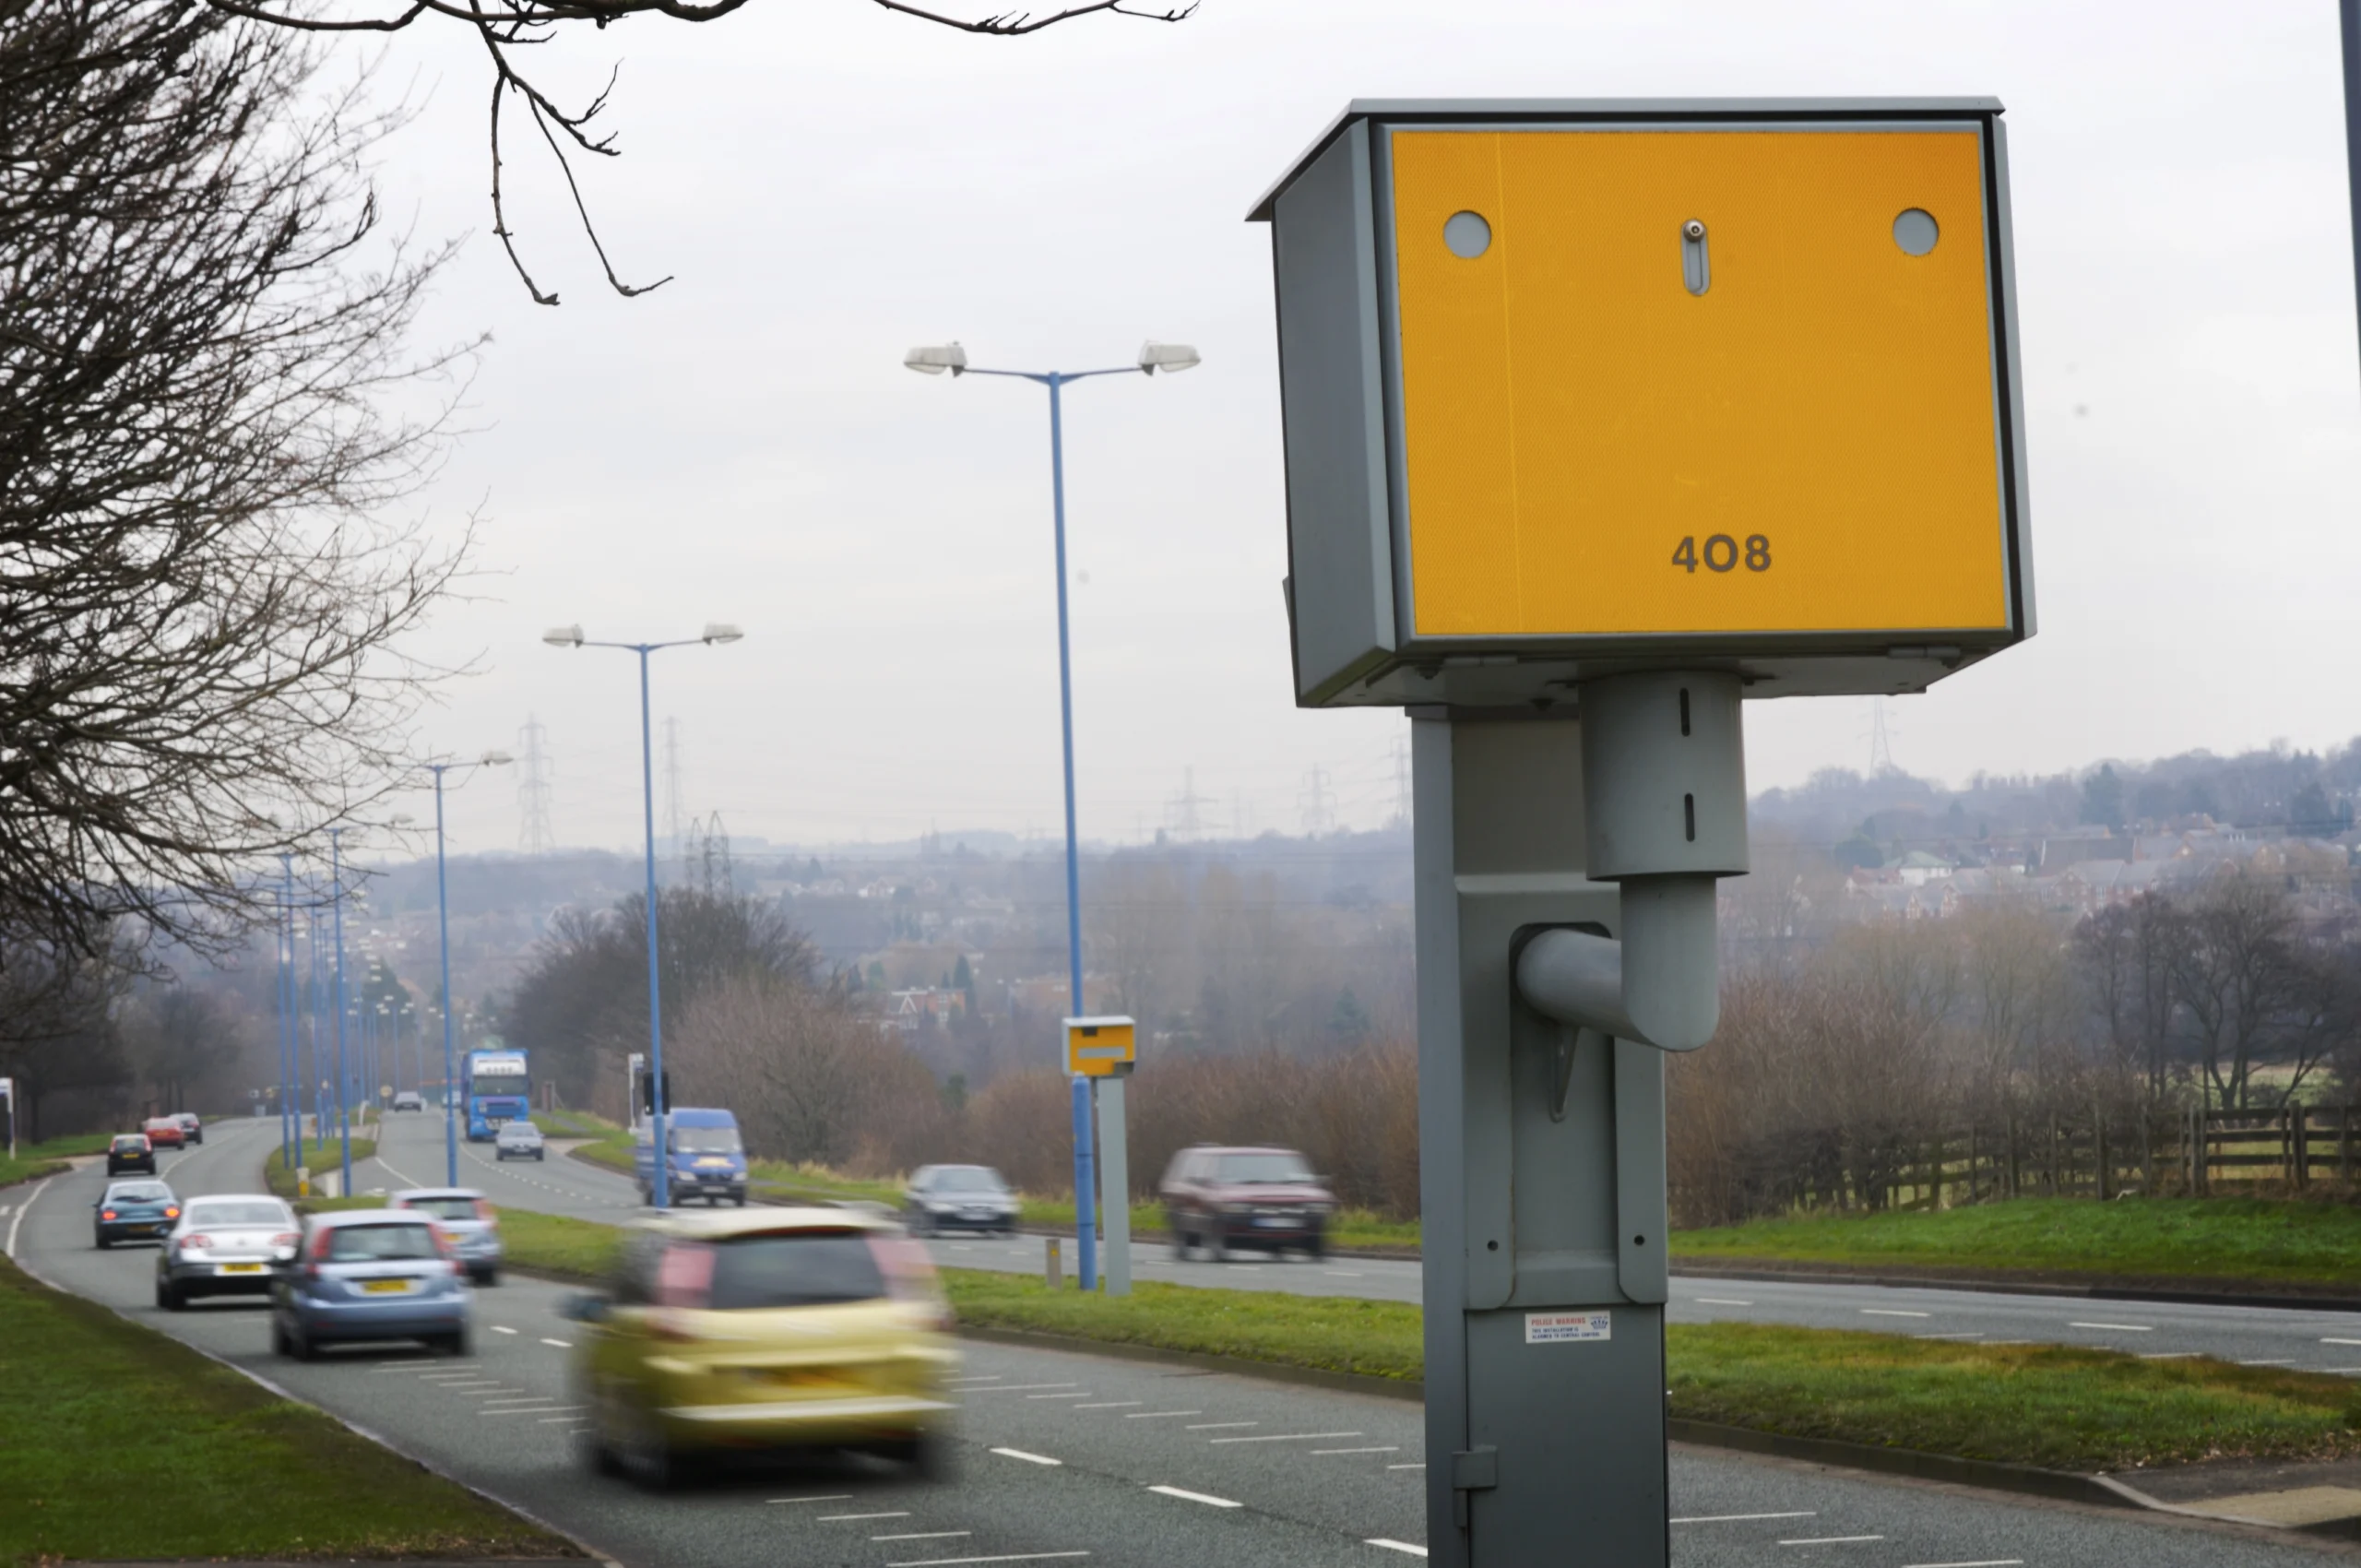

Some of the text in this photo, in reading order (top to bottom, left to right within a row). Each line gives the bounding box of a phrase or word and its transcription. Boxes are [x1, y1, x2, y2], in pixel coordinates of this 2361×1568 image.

[1672, 533, 1772, 574] 408
[1531, 1318, 1552, 1326] POLICE
[1556, 1316, 1586, 1325] WARNING
